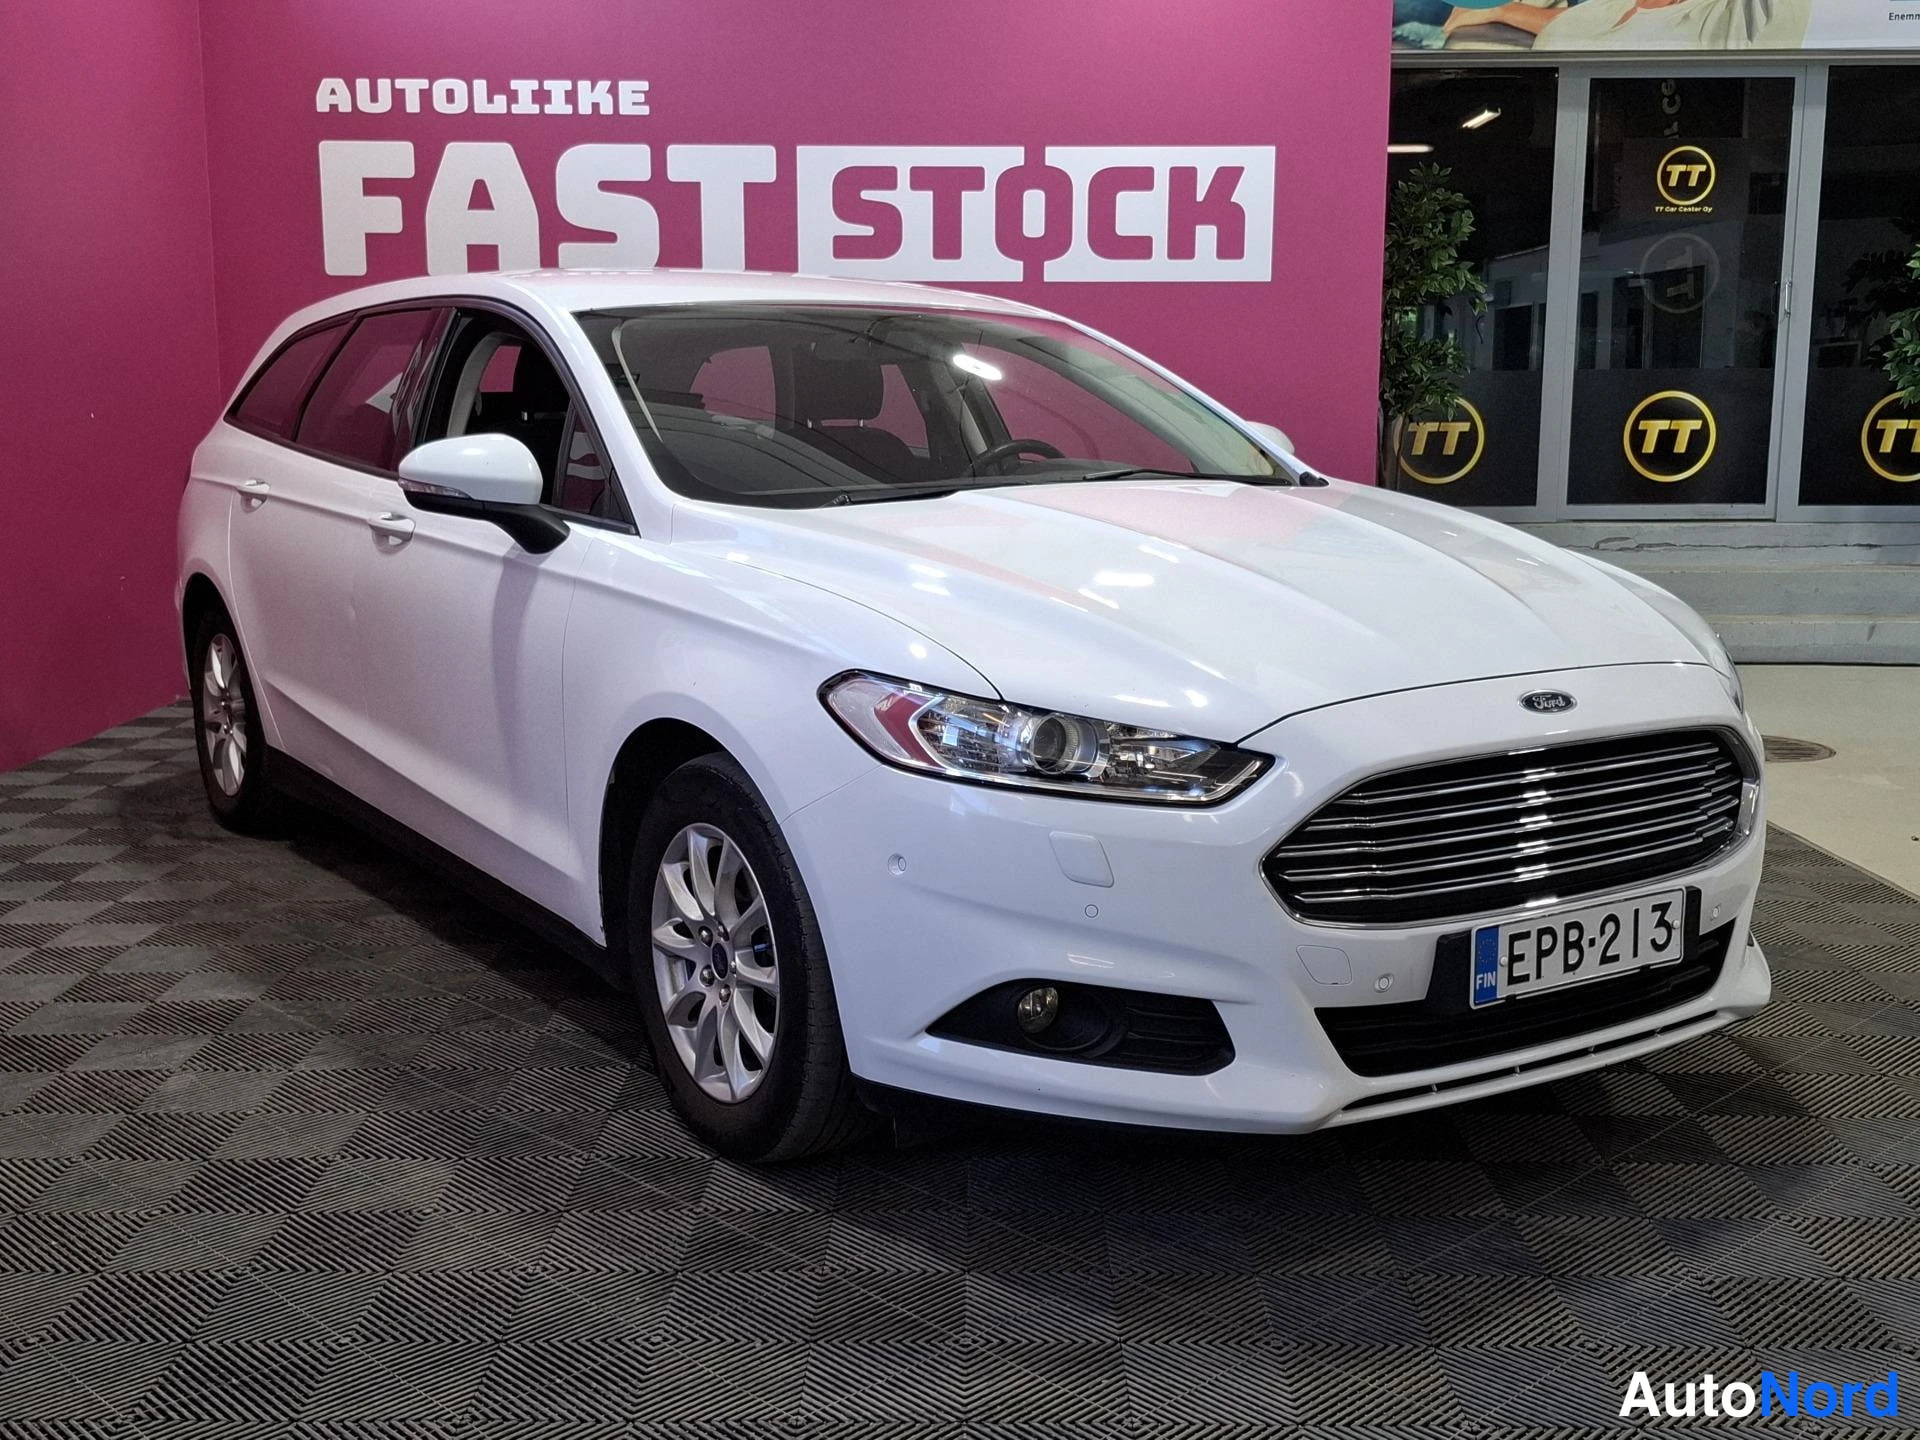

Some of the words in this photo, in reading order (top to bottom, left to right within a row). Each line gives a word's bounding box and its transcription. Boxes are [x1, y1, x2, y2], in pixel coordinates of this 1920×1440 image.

[316, 78, 650, 115] AUTOLIIKE
[1666, 164, 1707, 187] TT
[318, 140, 777, 276] FAST
[832, 164, 1247, 261] STOCK
[1408, 422, 1471, 455] TT
[1638, 420, 1703, 453] TT
[1532, 694, 1566, 709] Ford
[1475, 969, 1497, 988] FIN
